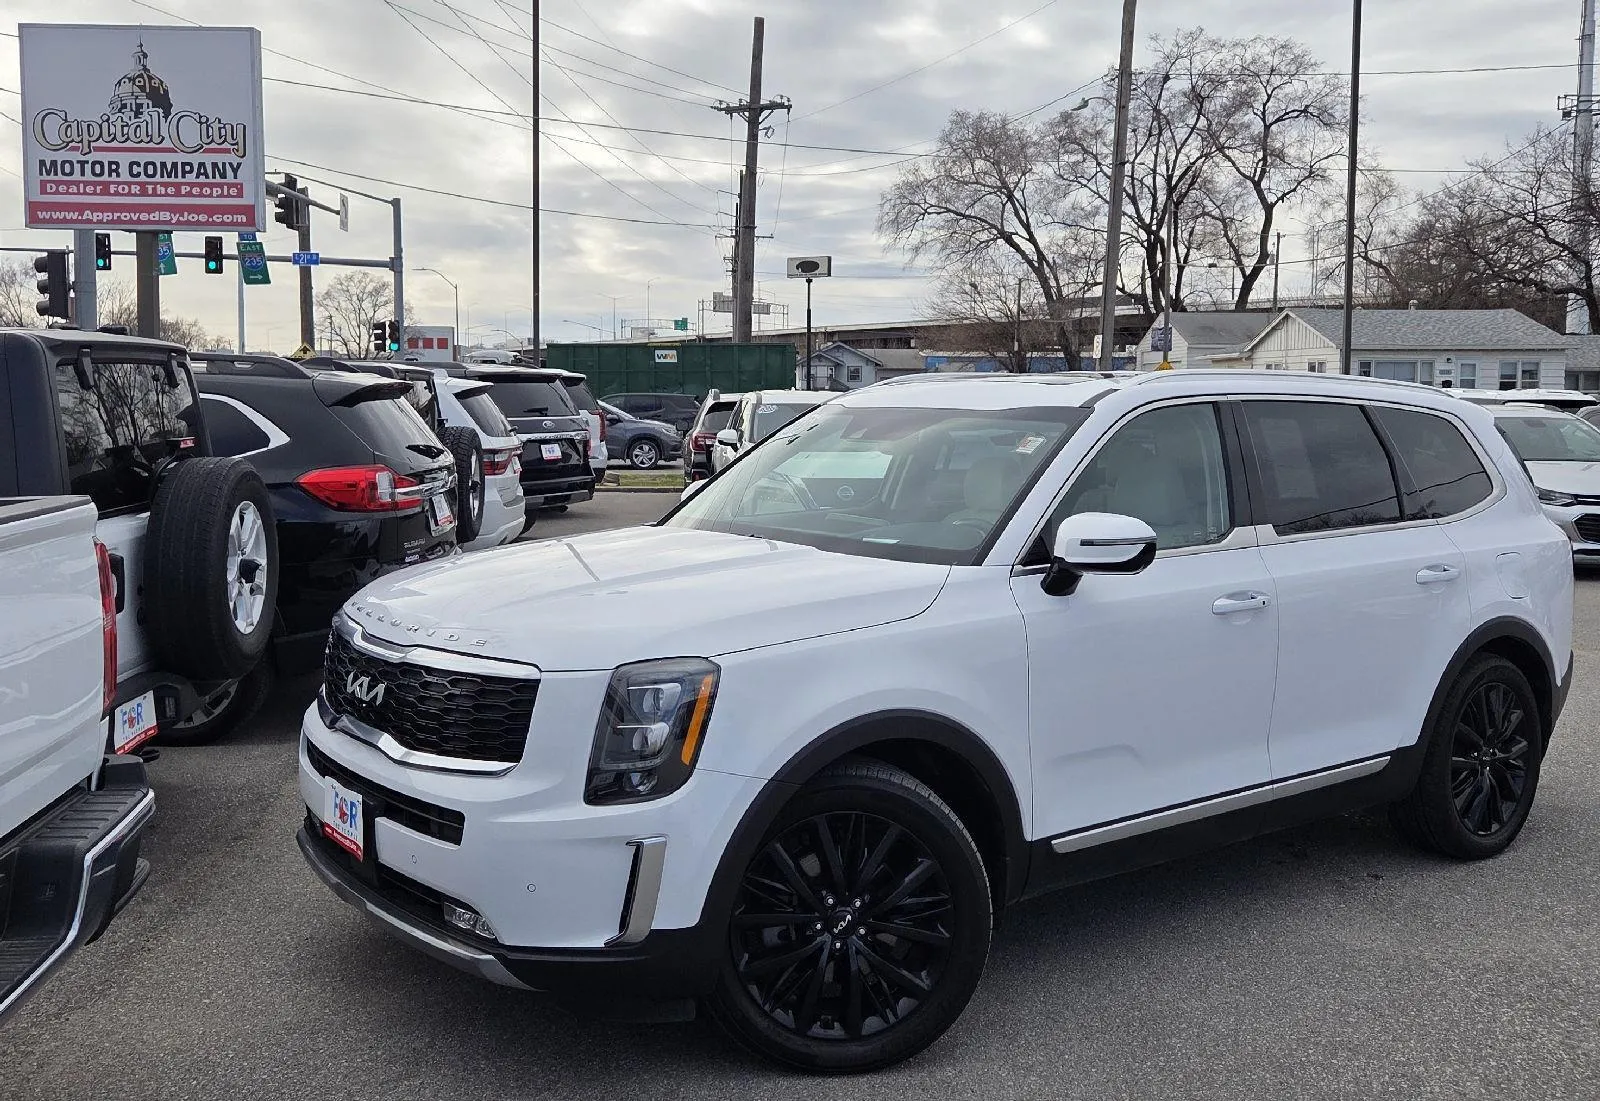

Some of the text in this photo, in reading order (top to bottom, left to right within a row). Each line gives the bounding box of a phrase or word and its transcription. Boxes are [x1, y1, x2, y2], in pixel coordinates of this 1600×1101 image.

[33, 108, 247, 159] Capital City
[38, 159, 243, 180] MOTOR COMPANY
[46, 183, 238, 198] Dealer FOR The People
[37, 209, 247, 223] www.ApprovedByJoe.com
[158, 246, 170, 256] 35
[240, 243, 260, 251] EAST
[245, 257, 263, 266] 235
[351, 601, 488, 647] TELLURIDE
[346, 669, 387, 706] KIA
[121, 702, 144, 734] FOR
[333, 790, 358, 832] FOR
